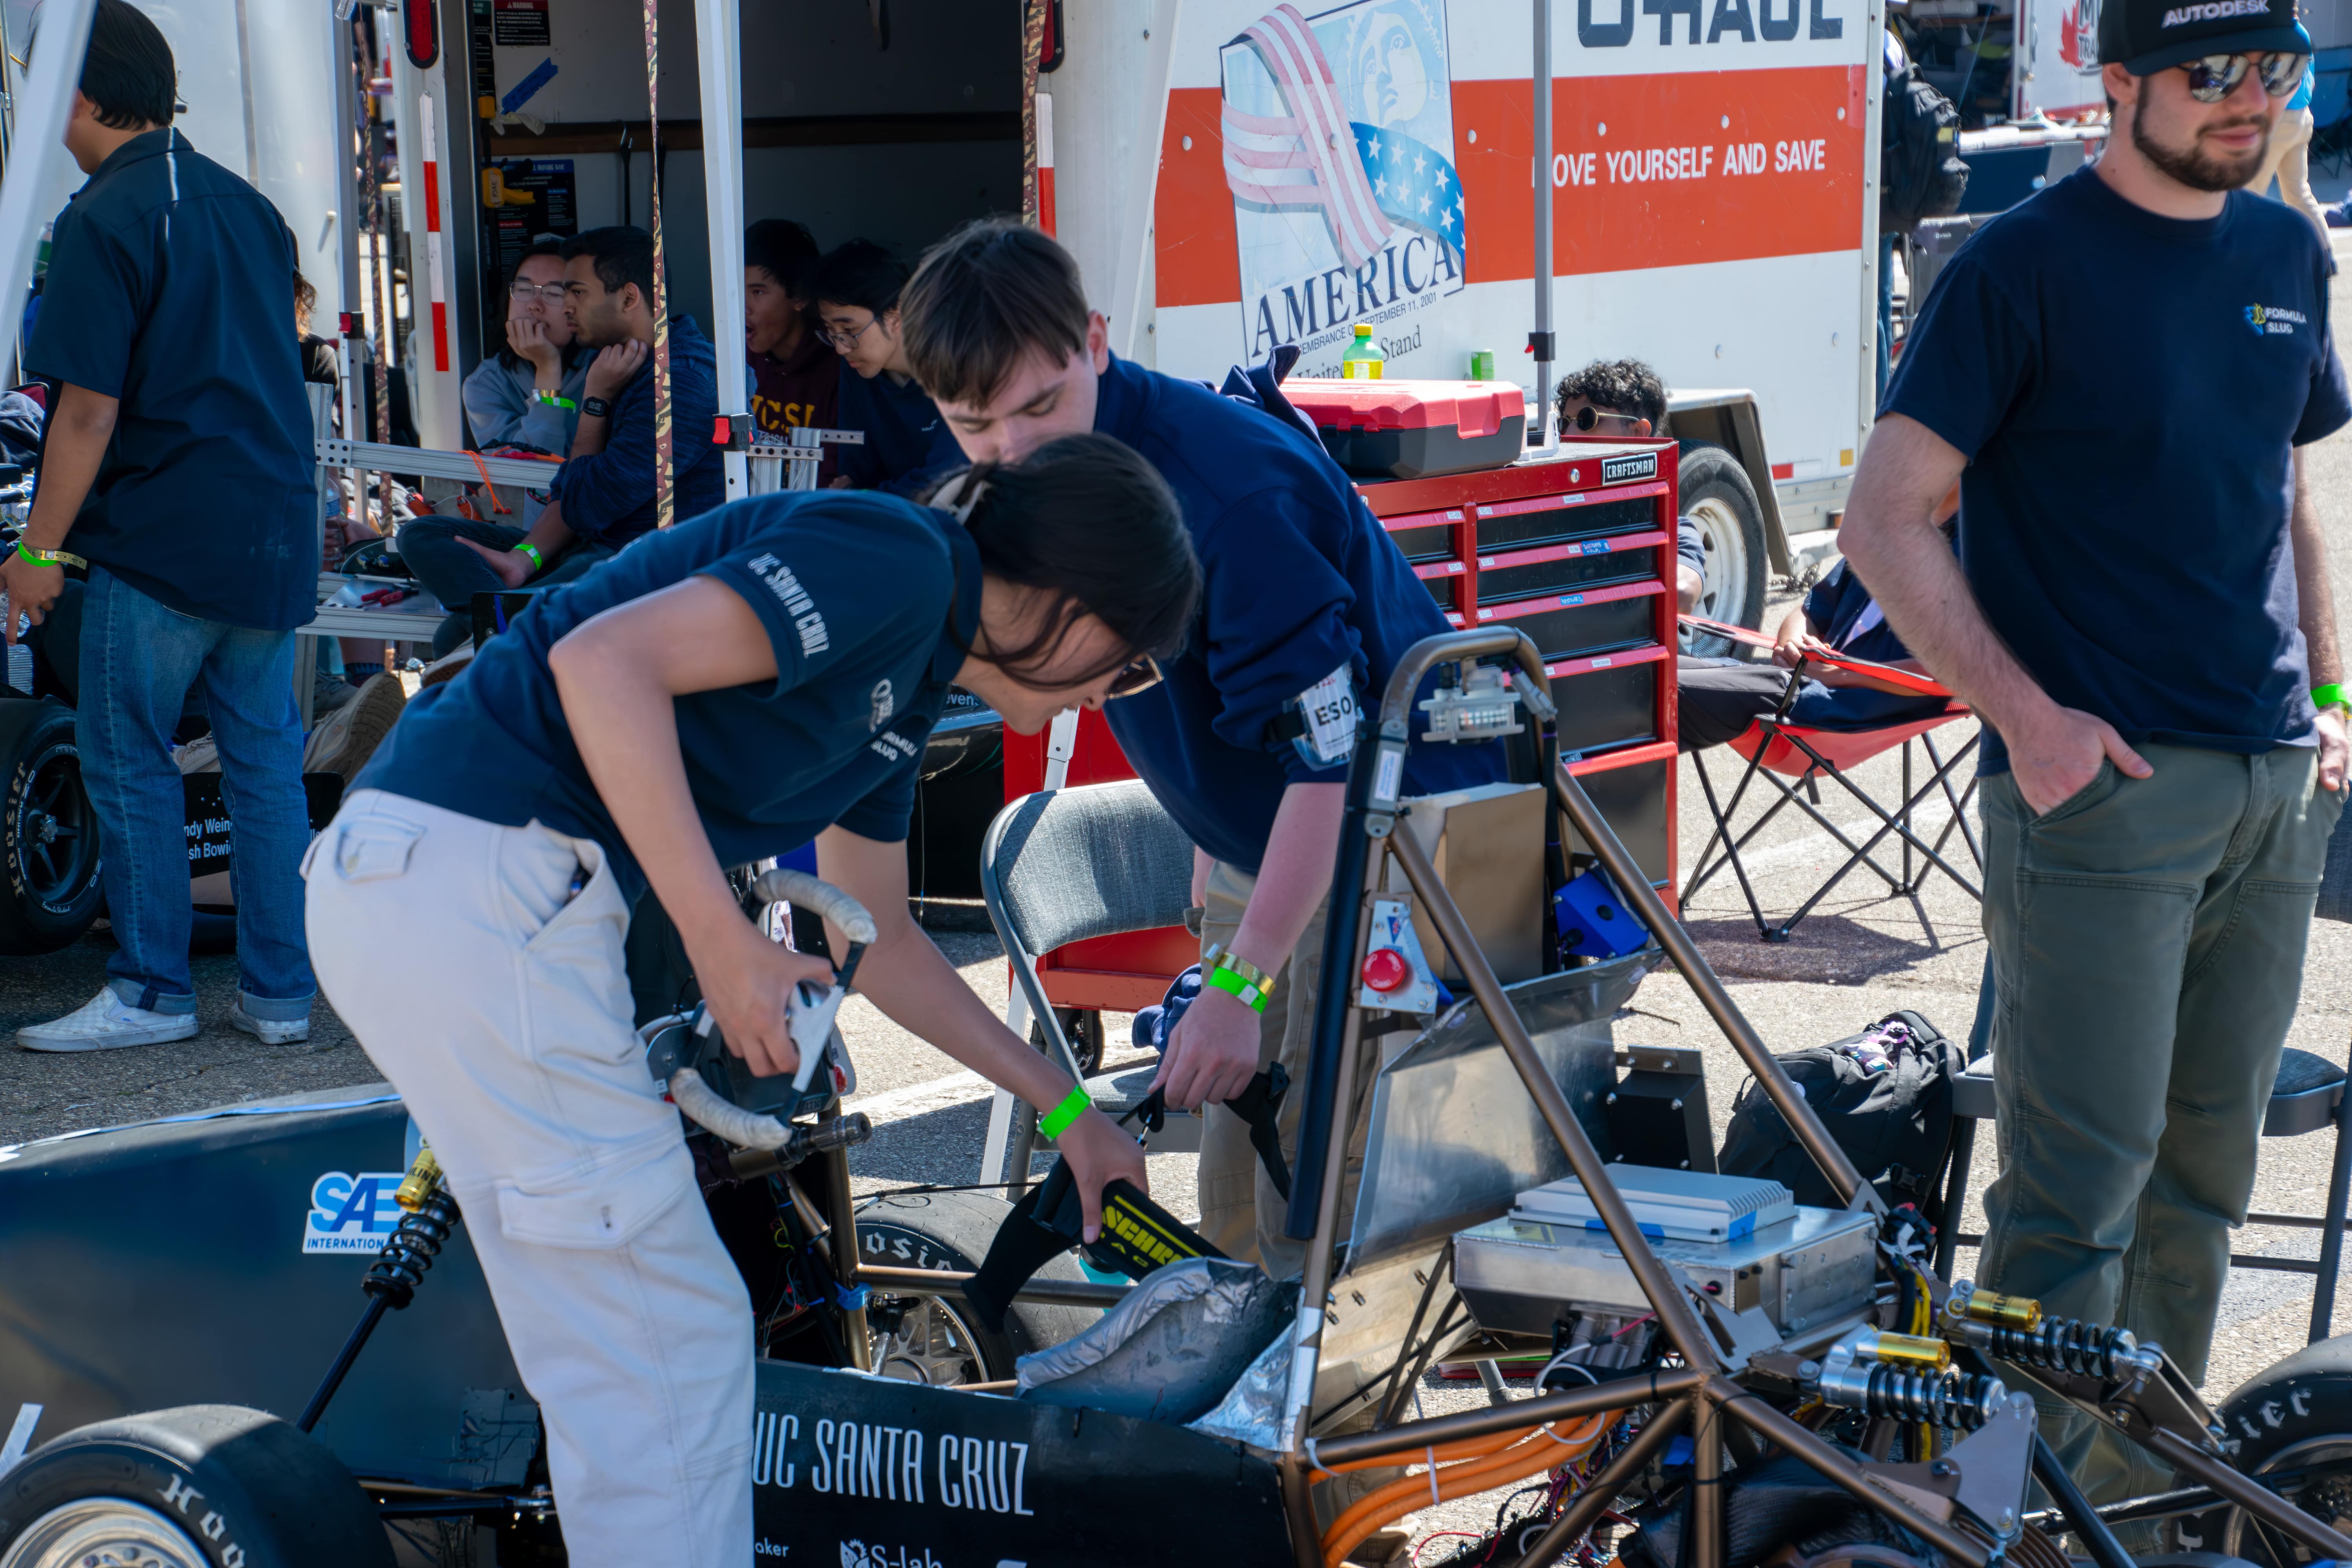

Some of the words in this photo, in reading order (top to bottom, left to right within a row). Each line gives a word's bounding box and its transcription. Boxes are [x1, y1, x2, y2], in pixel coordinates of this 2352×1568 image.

[2161, 0, 2270, 28] AUTODESK
[1532, 152, 1596, 188] OVE
[1606, 146, 1713, 183] YOURSELF
[1723, 142, 1767, 176] AND
[1775, 139, 1826, 172] SAVE
[1252, 234, 1459, 358] AMERICA
[1300, 327, 1347, 356] EMBRANCE
[1408, 299, 1420, 312] 11,
[1421, 291, 1437, 308] 2001
[2265, 307, 2307, 325] FORMULA
[2267, 321, 2293, 334] SLUG
[1607, 459, 1654, 479] CRAFTSMAN
[748, 552, 781, 575] UC
[764, 566, 814, 617] SANTA
[795, 612, 830, 659] CRUZ
[1315, 696, 1352, 727] ESO
[5, 762, 26, 898] Hoosier
[205, 817, 232, 834] Wein
[311, 1177, 405, 1232] SAE
[307, 1238, 385, 1249] INTERNATION
[752, 1411, 799, 1488] UC
[812, 1419, 924, 1504] SANTA
[938, 1434, 1034, 1516] CRUZ
[755, 1537, 789, 1557] aker
